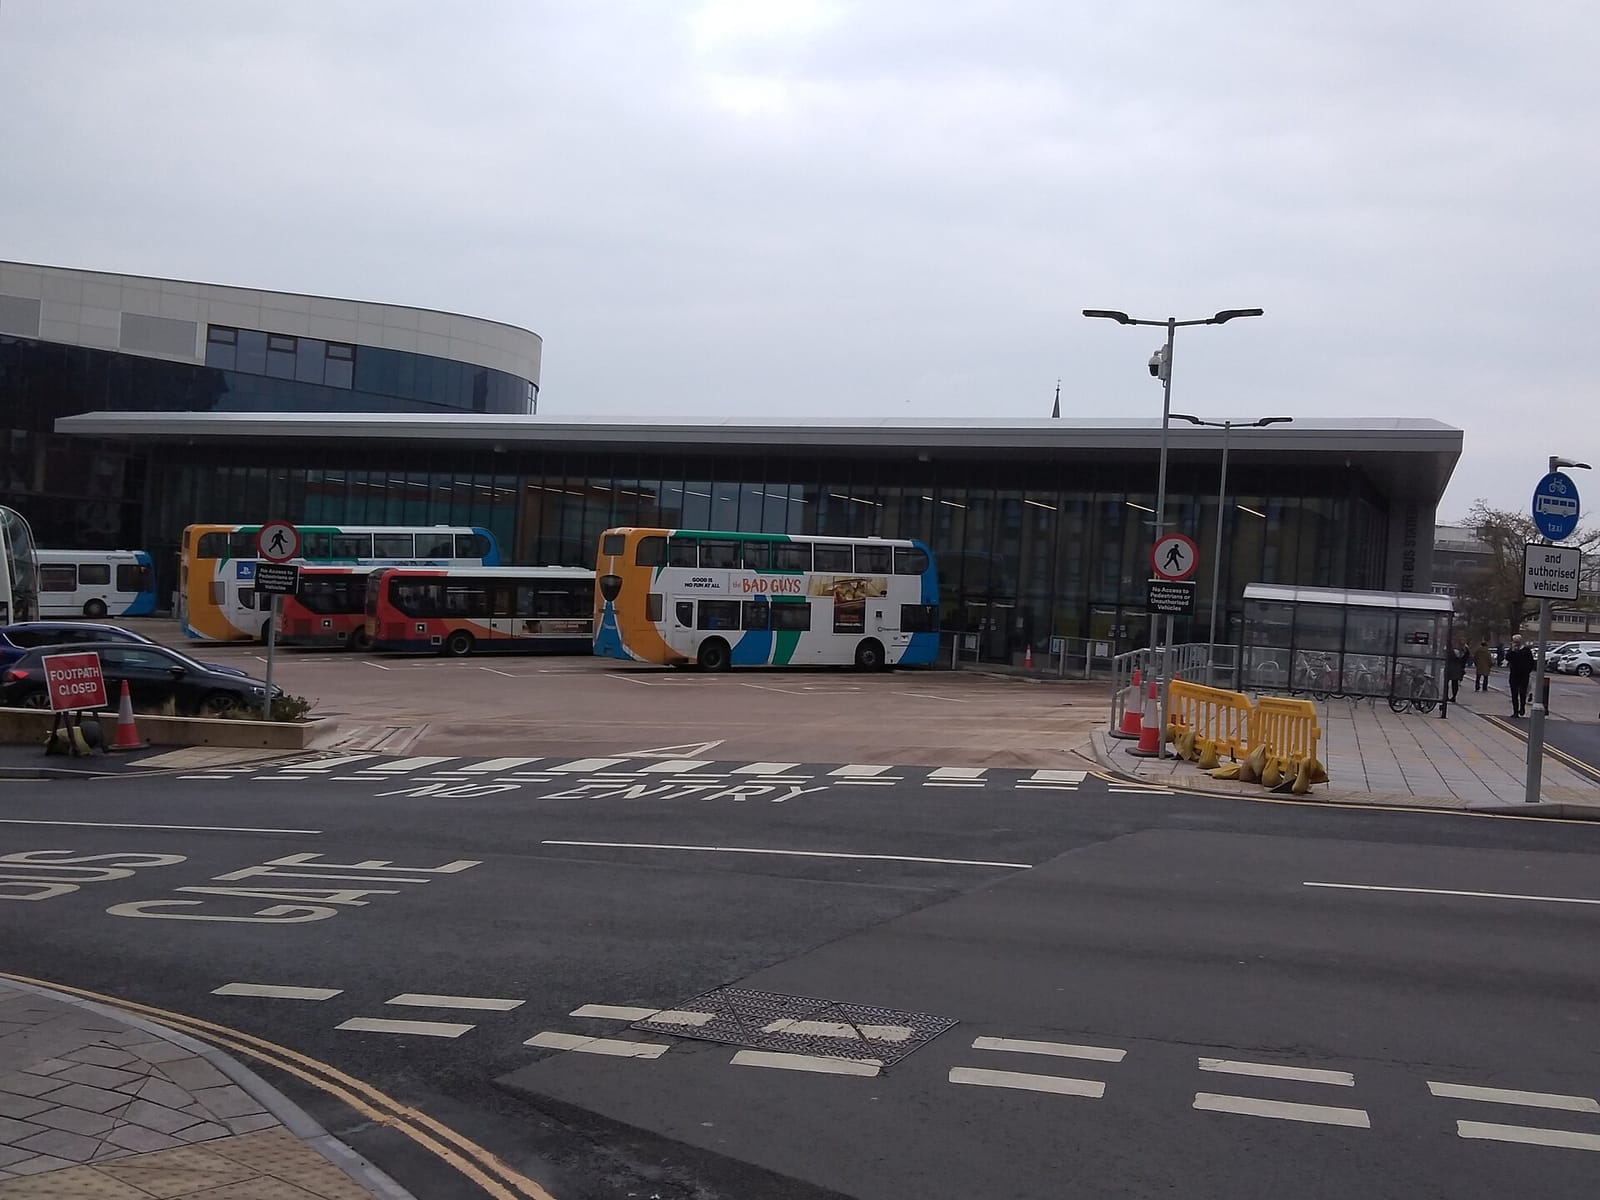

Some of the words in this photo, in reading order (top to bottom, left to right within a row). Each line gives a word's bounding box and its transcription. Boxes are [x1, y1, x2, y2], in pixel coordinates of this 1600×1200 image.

[1548, 522, 1563, 532] taxi
[1403, 550, 1416, 572] BUS
[1544, 553, 1562, 564] and
[1528, 566, 1576, 580] authorised
[742, 578, 768, 593] BAD
[770, 578, 802, 594] GUYS
[1533, 580, 1569, 593] vehicles
[1150, 592, 1183, 600] Pedestrians
[1151, 598, 1189, 606] Unauthorised
[50, 667, 100, 681] FOOTPATH
[59, 682, 98, 696] CLOSED
[374, 783, 521, 799] NO
[538, 784, 829, 802] ENTRY
[105, 852, 484, 923] GATE
